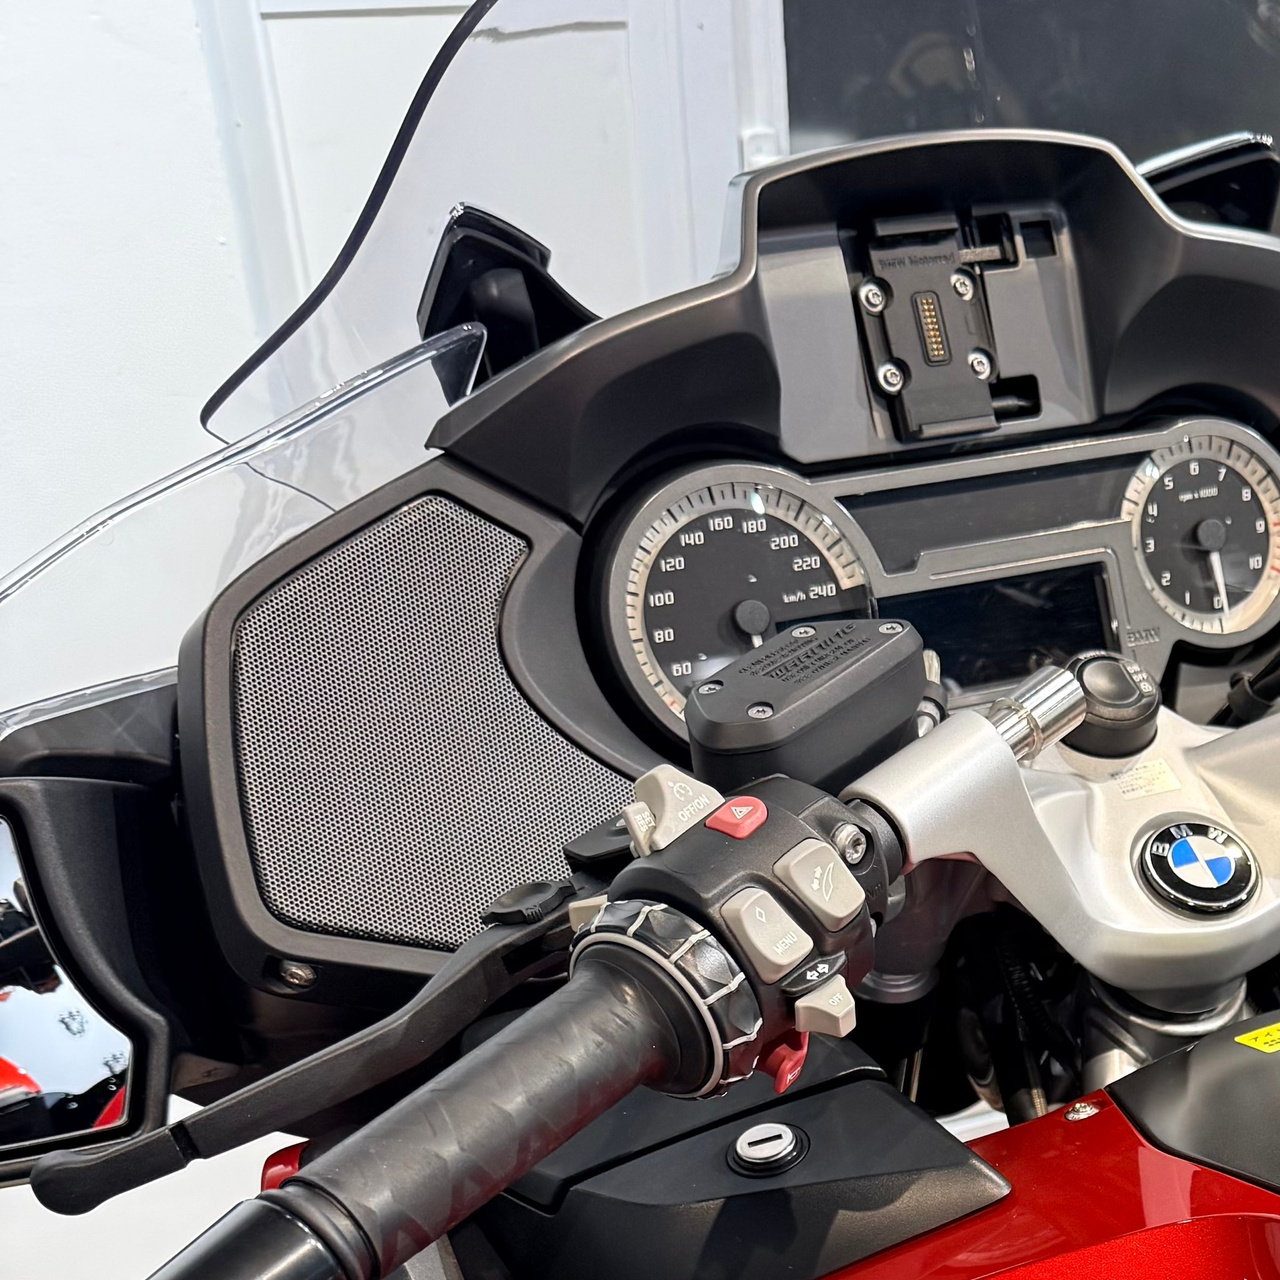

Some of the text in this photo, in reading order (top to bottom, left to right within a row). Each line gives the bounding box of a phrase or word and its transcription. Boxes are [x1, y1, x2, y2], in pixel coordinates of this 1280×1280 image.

[1189, 462, 1200, 475] 6
[1217, 466, 1227, 481] 7
[1164, 476, 1174, 490] 5
[1241, 487, 1252, 501] 8
[1147, 503, 1158, 517] 4
[709, 515, 734, 531] 160
[742, 519, 767, 533] 180
[1255, 520, 1265, 533] 9
[679, 531, 704, 547] 140
[771, 534, 798, 550] 200
[1145, 540, 1155, 553] 3
[660, 556, 685, 572] 120
[793, 556, 821, 571] 220
[1249, 556, 1262, 570] 10
[1161, 572, 1171, 586] 2
[648, 591, 675, 607] 100
[782, 583, 836, 604] km/h 240
[653, 627, 675, 643] 80
[671, 661, 692, 677] 60
[1127, 664, 1140, 673] ON
[1133, 673, 1148, 682] OFF
[678, 794, 710, 822] OFF/ON
[634, 813, 649, 832] RES
[641, 811, 656, 828] SET
[1151, 824, 1229, 857] BMW
[773, 931, 799, 956] MENU
[829, 992, 844, 1007] OFF
